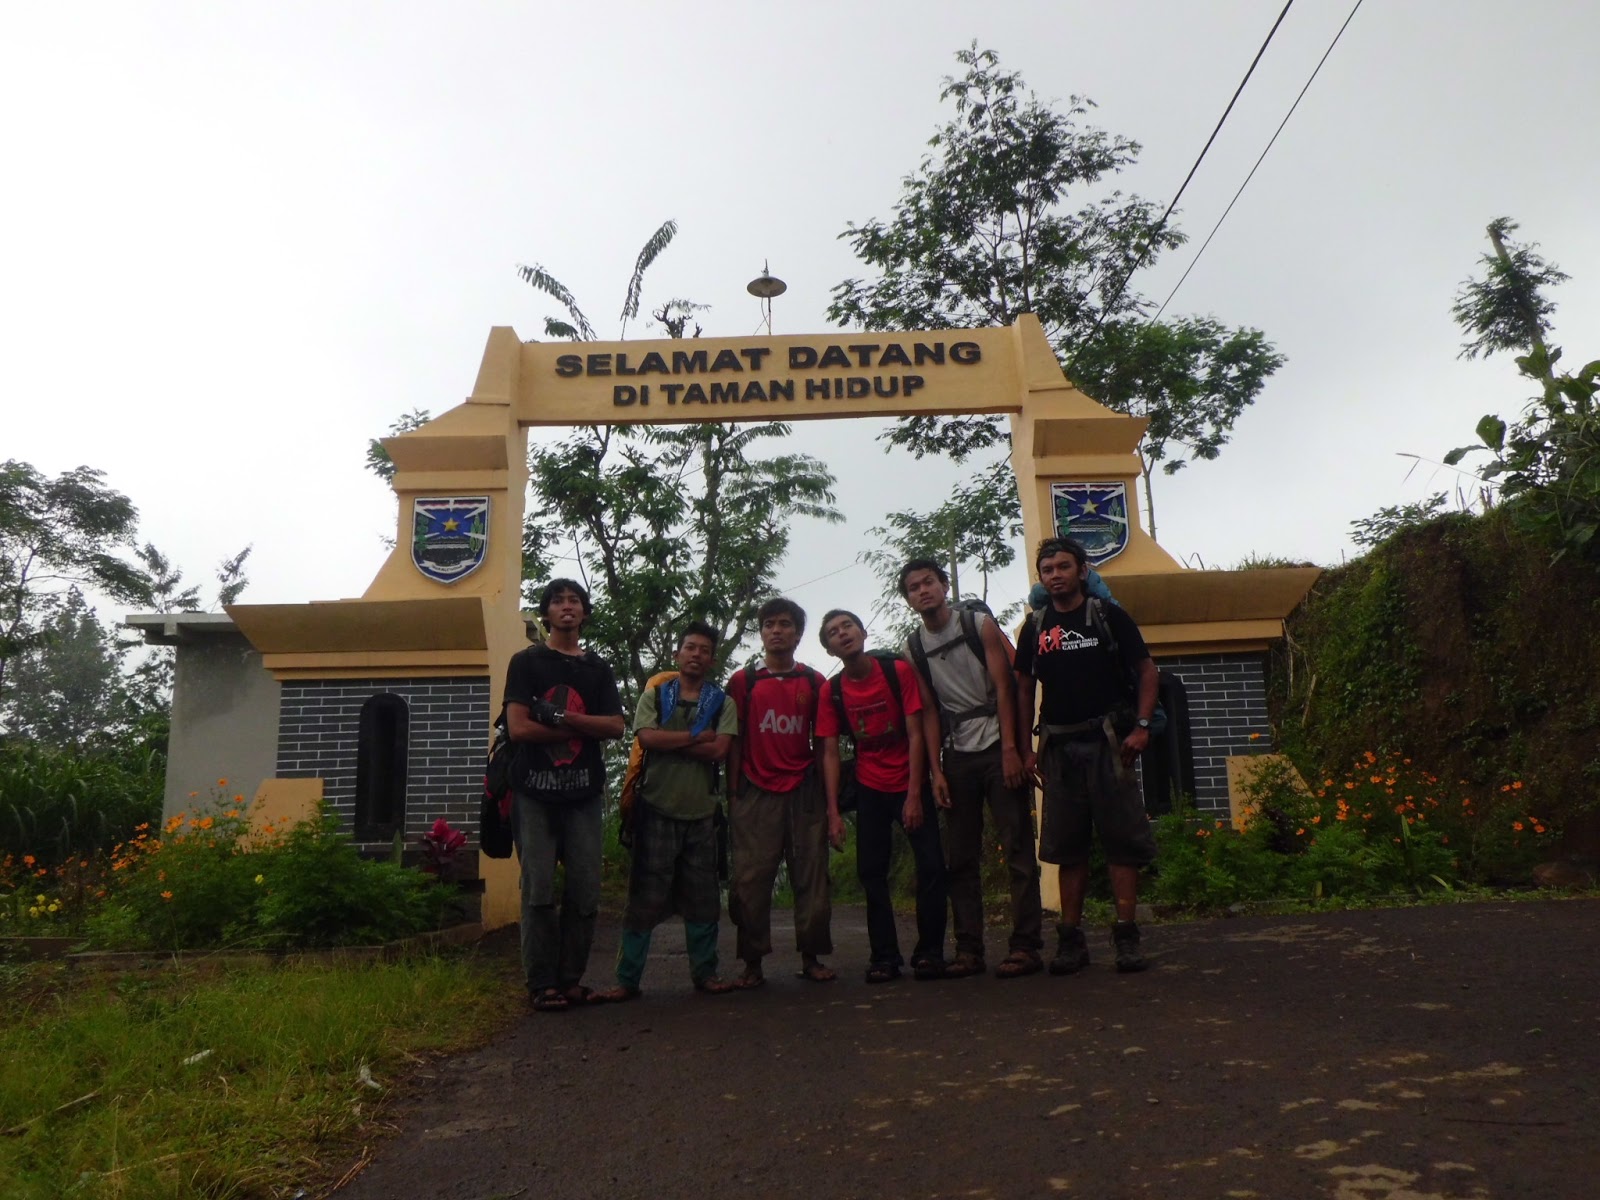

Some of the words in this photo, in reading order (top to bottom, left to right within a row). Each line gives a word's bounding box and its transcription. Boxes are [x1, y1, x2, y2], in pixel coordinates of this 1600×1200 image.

[555, 348, 771, 378] SELAMAT
[788, 342, 982, 369] DATANG
[613, 385, 650, 407] DI
[659, 380, 795, 406] TAMAN
[805, 375, 925, 401] HIDUP
